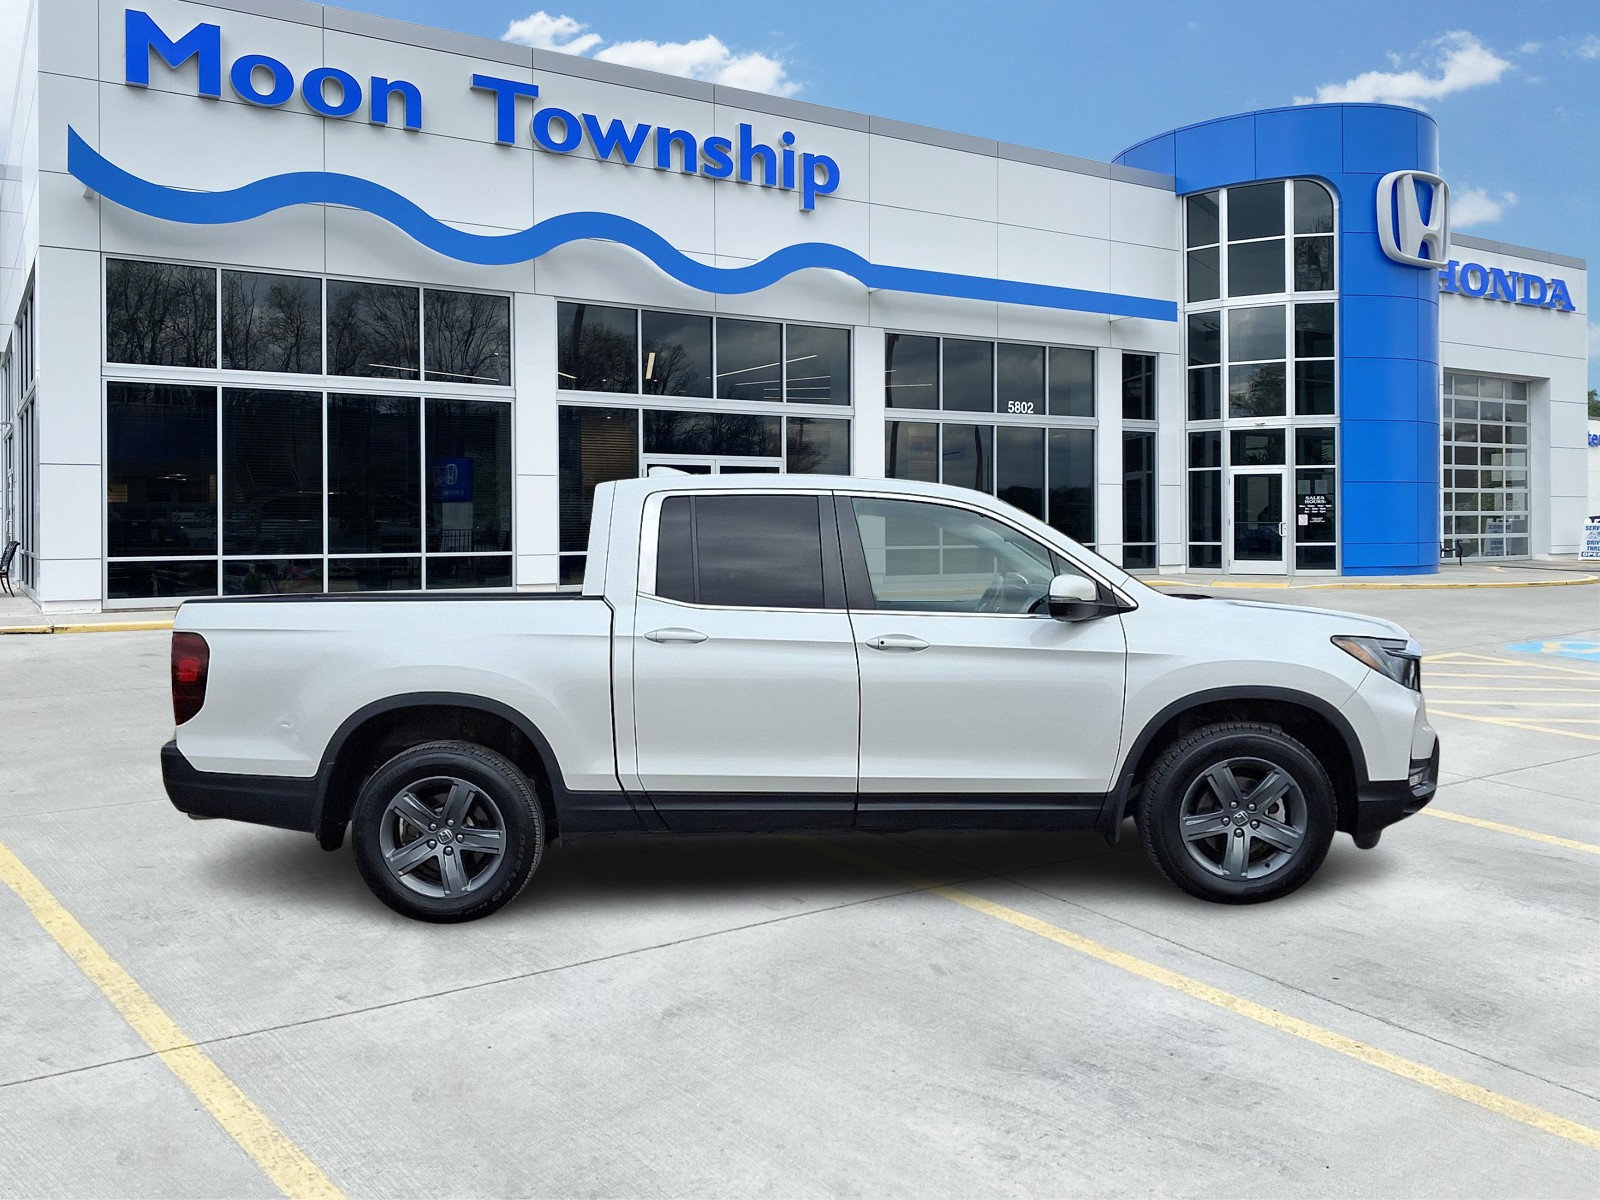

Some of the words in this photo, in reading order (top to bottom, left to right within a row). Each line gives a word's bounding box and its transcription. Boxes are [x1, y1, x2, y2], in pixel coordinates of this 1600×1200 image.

[125, 9, 422, 131] Moon
[472, 74, 840, 211] Township
[1438, 260, 1576, 311] HONDA
[1008, 401, 1034, 413] 5802
